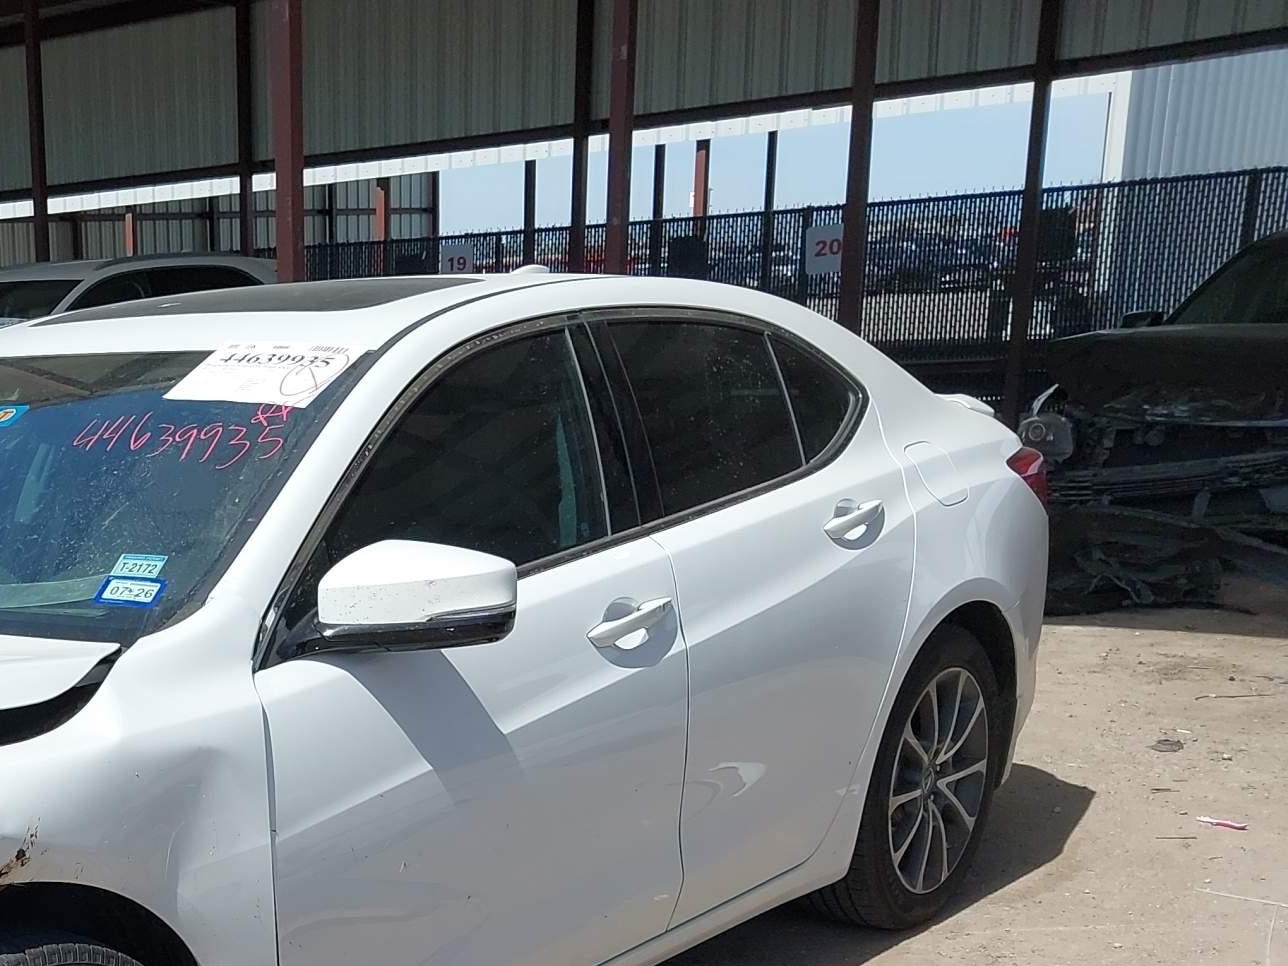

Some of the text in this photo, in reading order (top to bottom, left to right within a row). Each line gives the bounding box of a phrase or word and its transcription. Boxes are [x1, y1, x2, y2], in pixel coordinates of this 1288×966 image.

[814, 238, 842, 257] 20
[447, 256, 467, 272] 19
[218, 352, 336, 368] 44639935
[72, 411, 286, 470] 44639935
[119, 561, 158, 574] T-2172
[109, 586, 155, 599] 07 26
